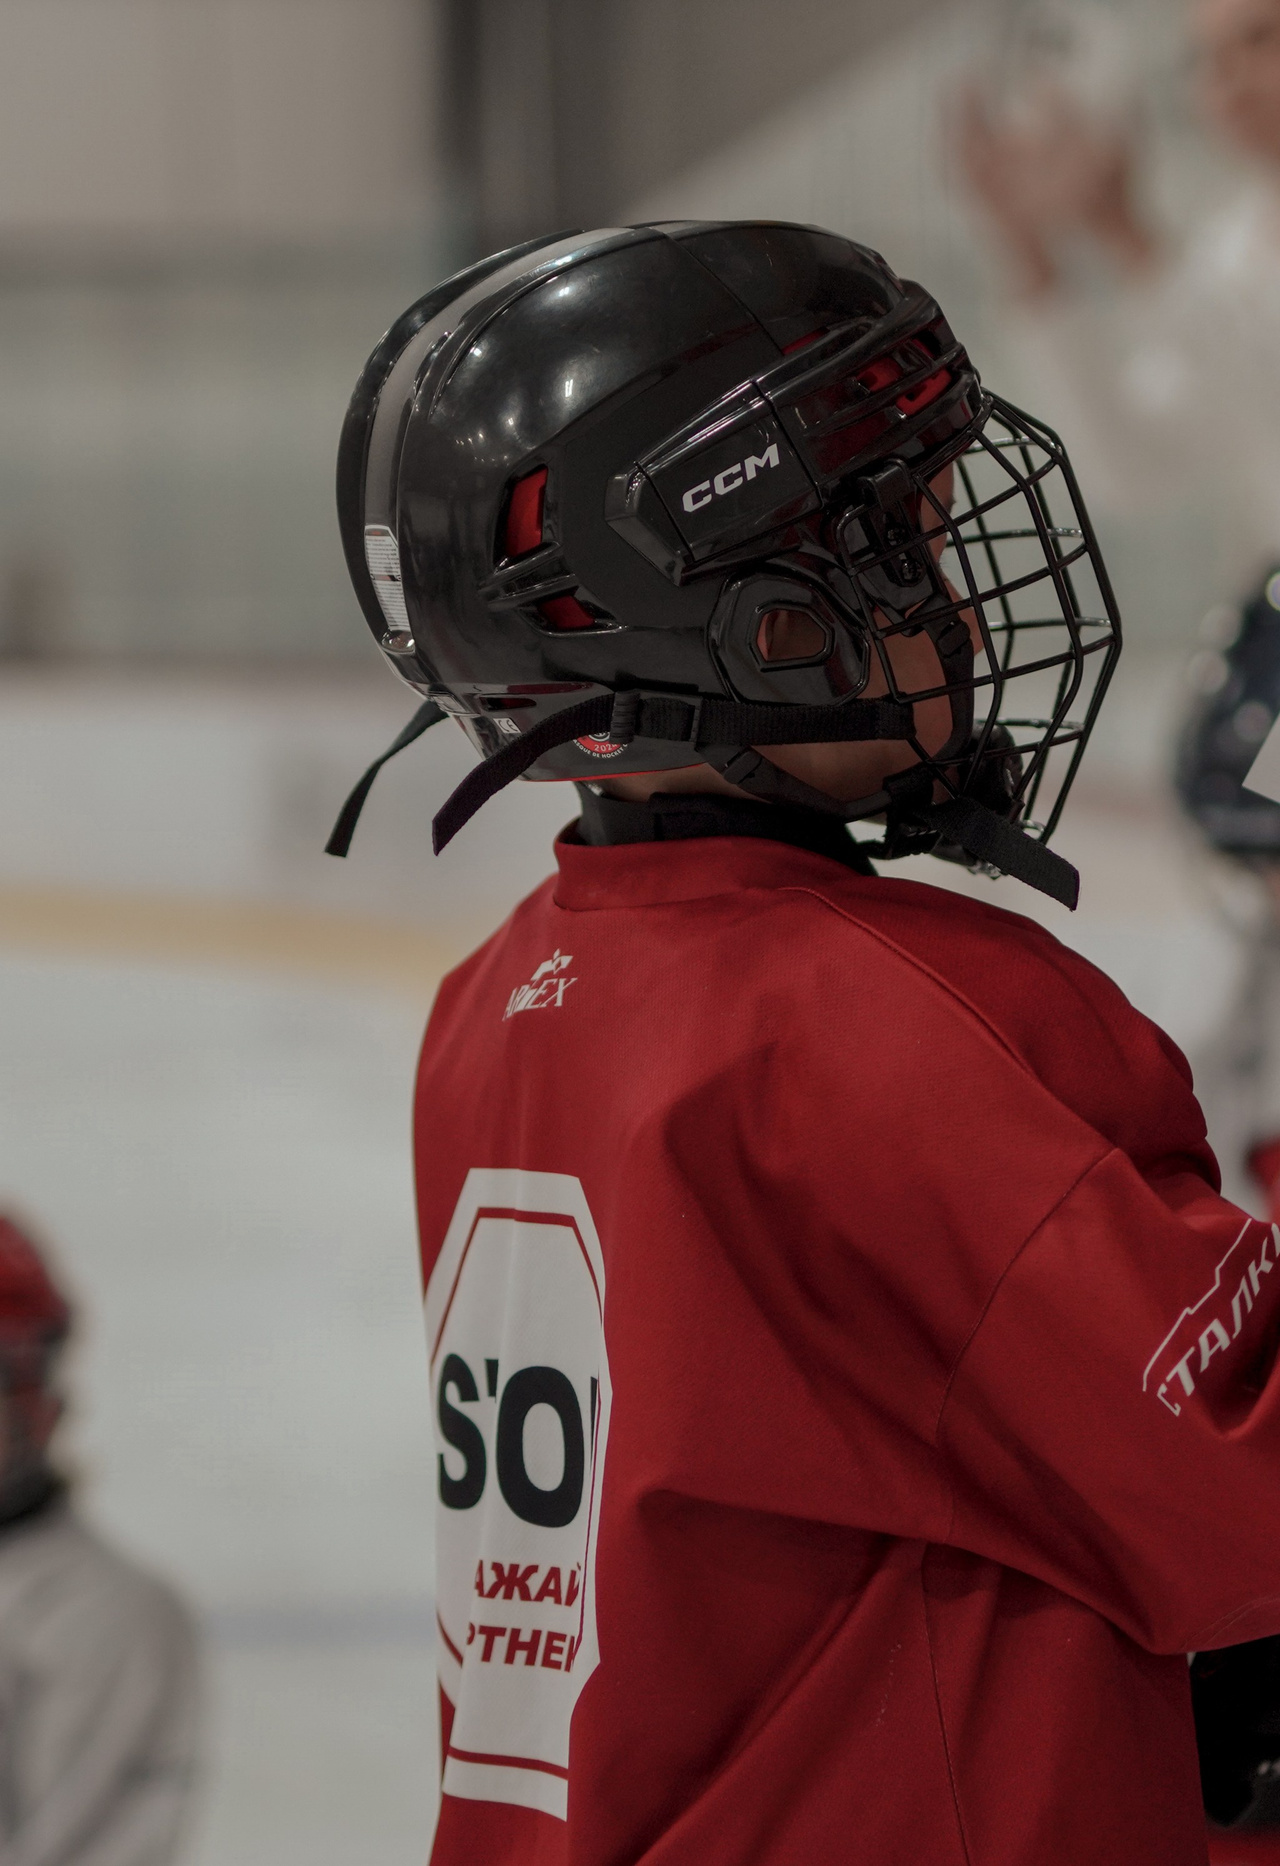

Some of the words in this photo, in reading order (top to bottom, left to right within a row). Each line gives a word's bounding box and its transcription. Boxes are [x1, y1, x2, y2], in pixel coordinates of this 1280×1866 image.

[682, 443, 780, 513] CCM
[601, 747, 625, 759] HOCKEY
[436, 1353, 598, 1528] SO
[474, 1559, 581, 1607] АЖАЙ
